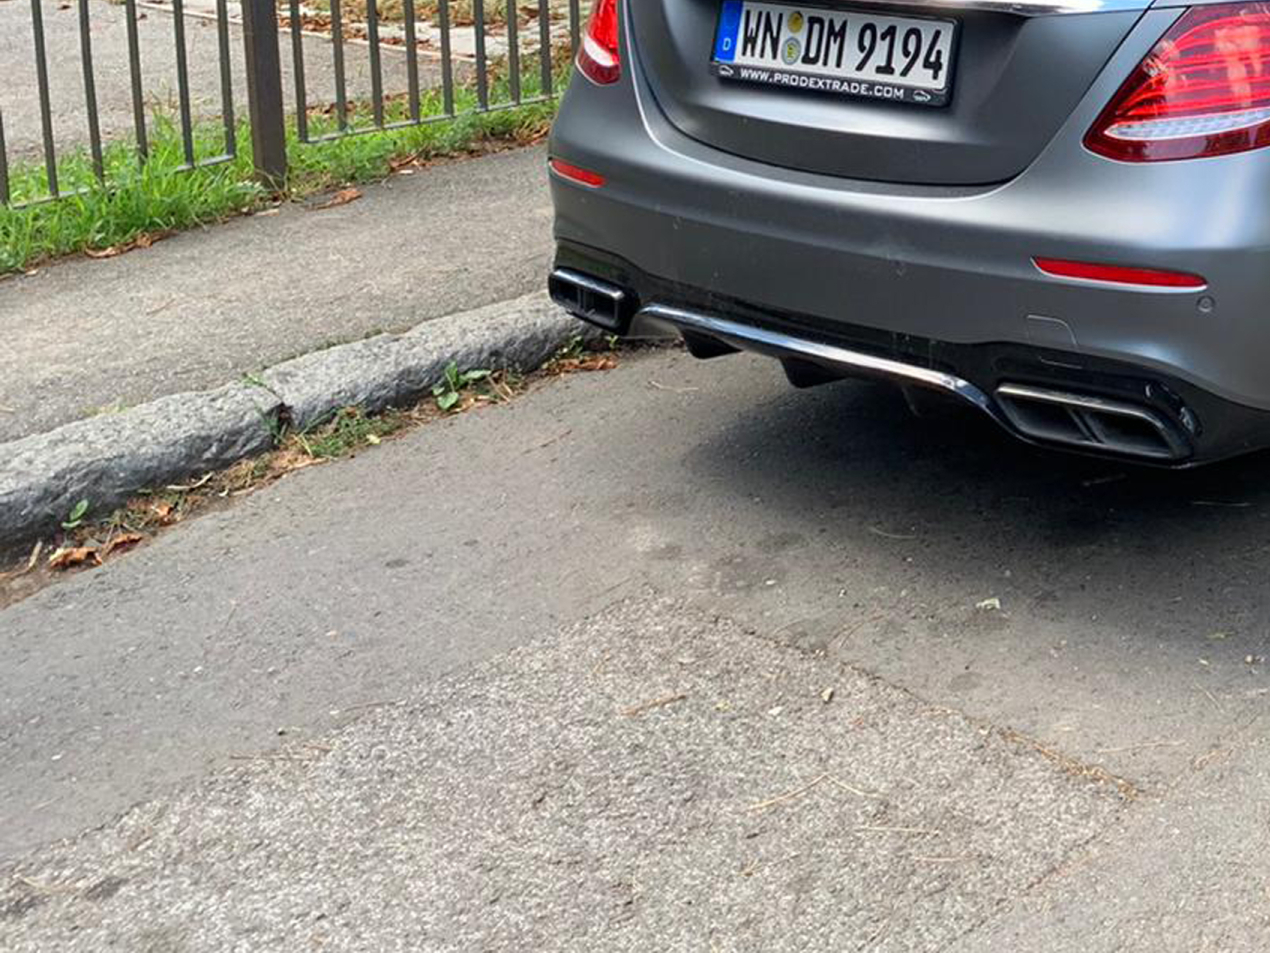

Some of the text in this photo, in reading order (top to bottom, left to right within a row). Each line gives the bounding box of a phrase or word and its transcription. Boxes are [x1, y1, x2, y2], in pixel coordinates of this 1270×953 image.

[741, 9, 943, 81] WN DM 9194
[740, 67, 905, 99] WWW.PRODEXTRADE.COM
